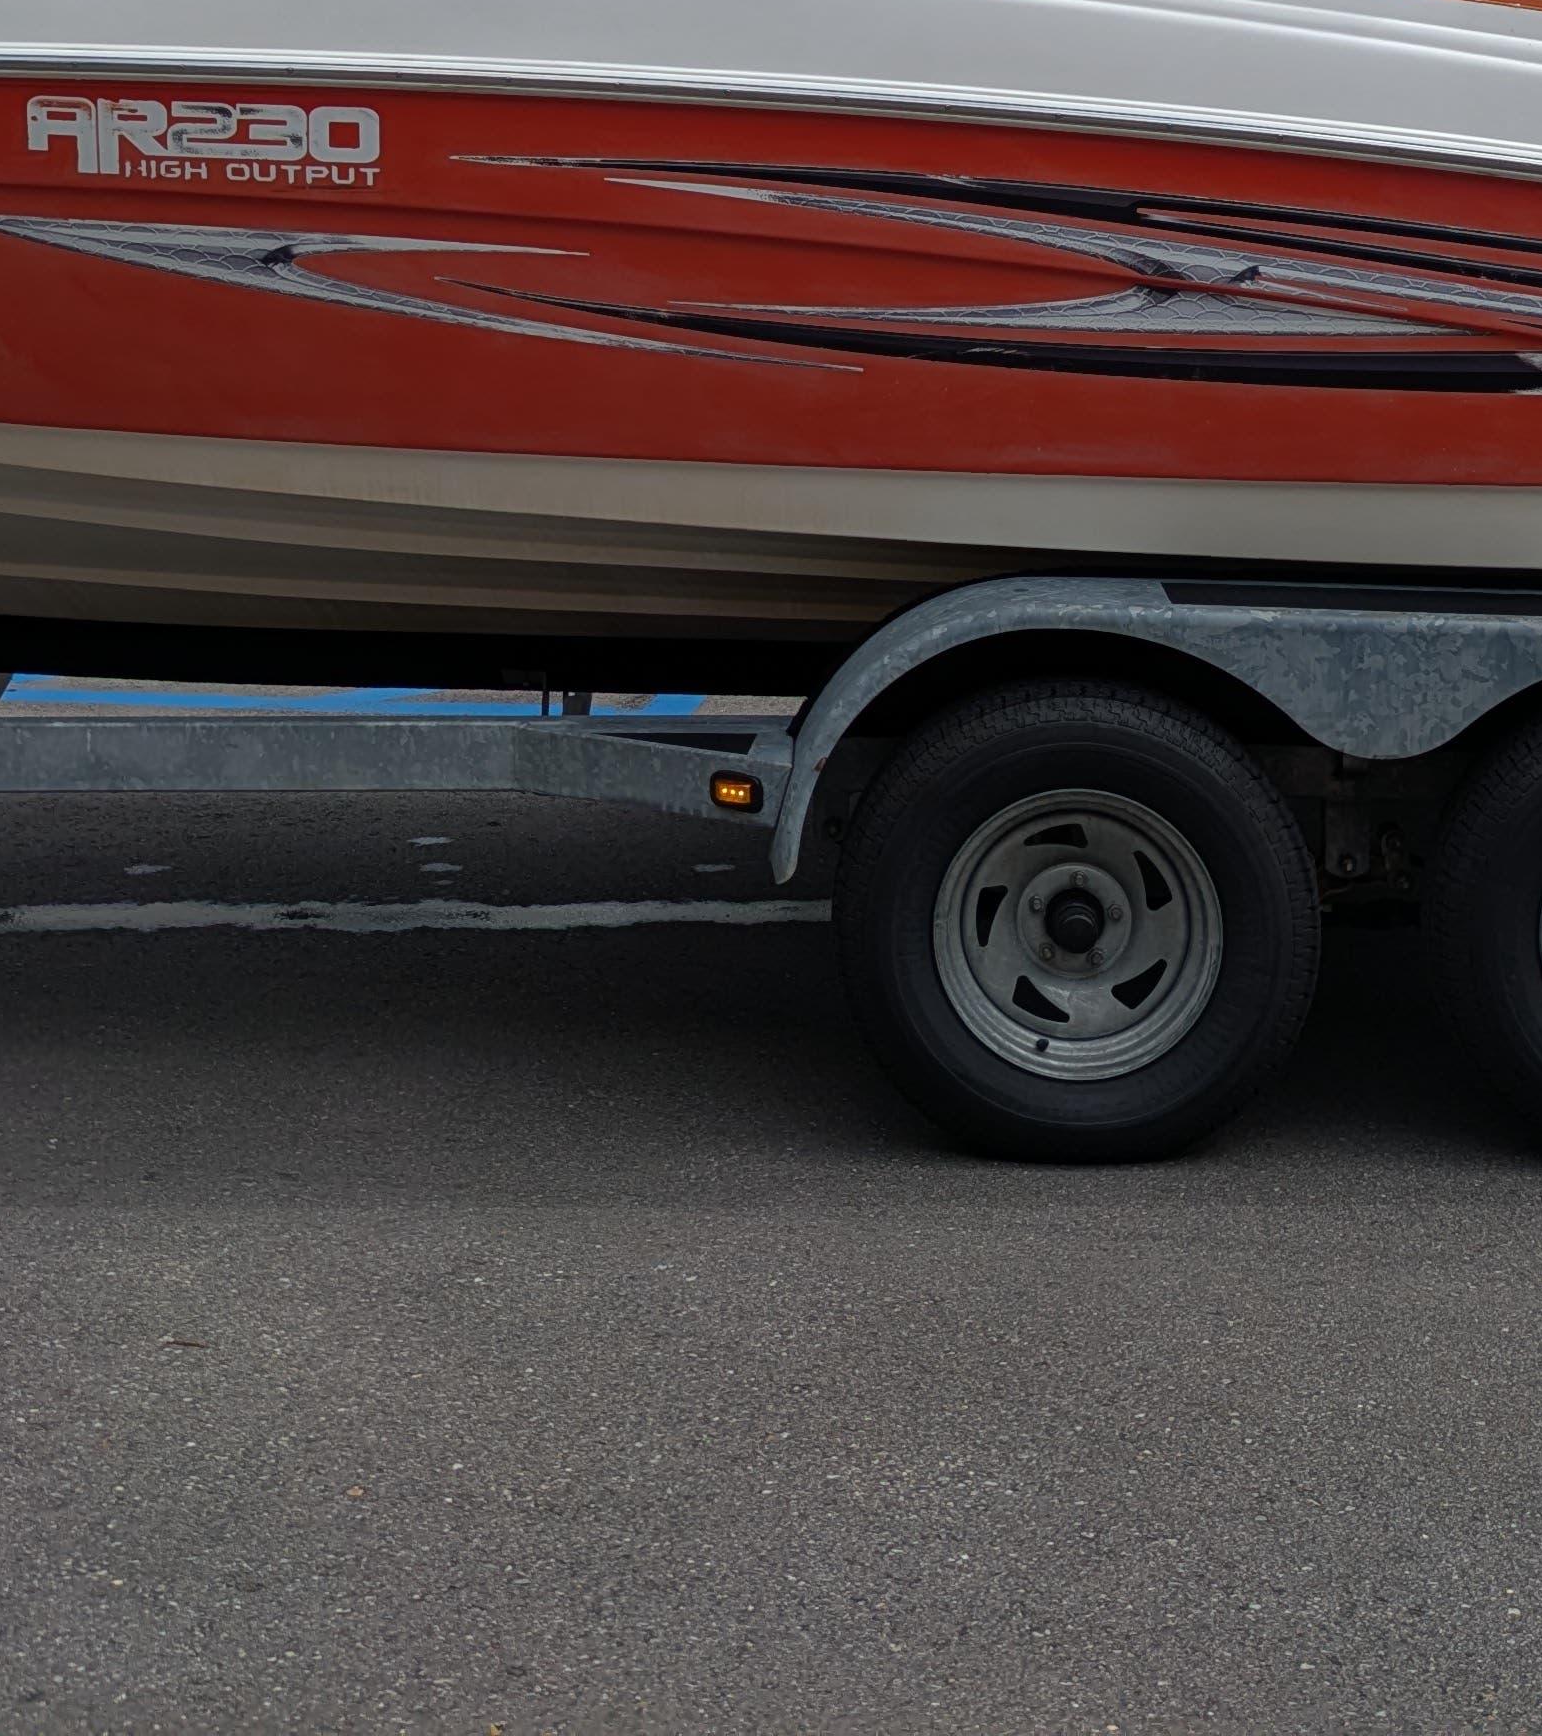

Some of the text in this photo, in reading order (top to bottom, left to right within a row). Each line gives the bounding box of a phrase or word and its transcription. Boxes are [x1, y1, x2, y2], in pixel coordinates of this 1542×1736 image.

[27, 95, 380, 174] AR230
[125, 159, 380, 186] HIGH OUTPUT
